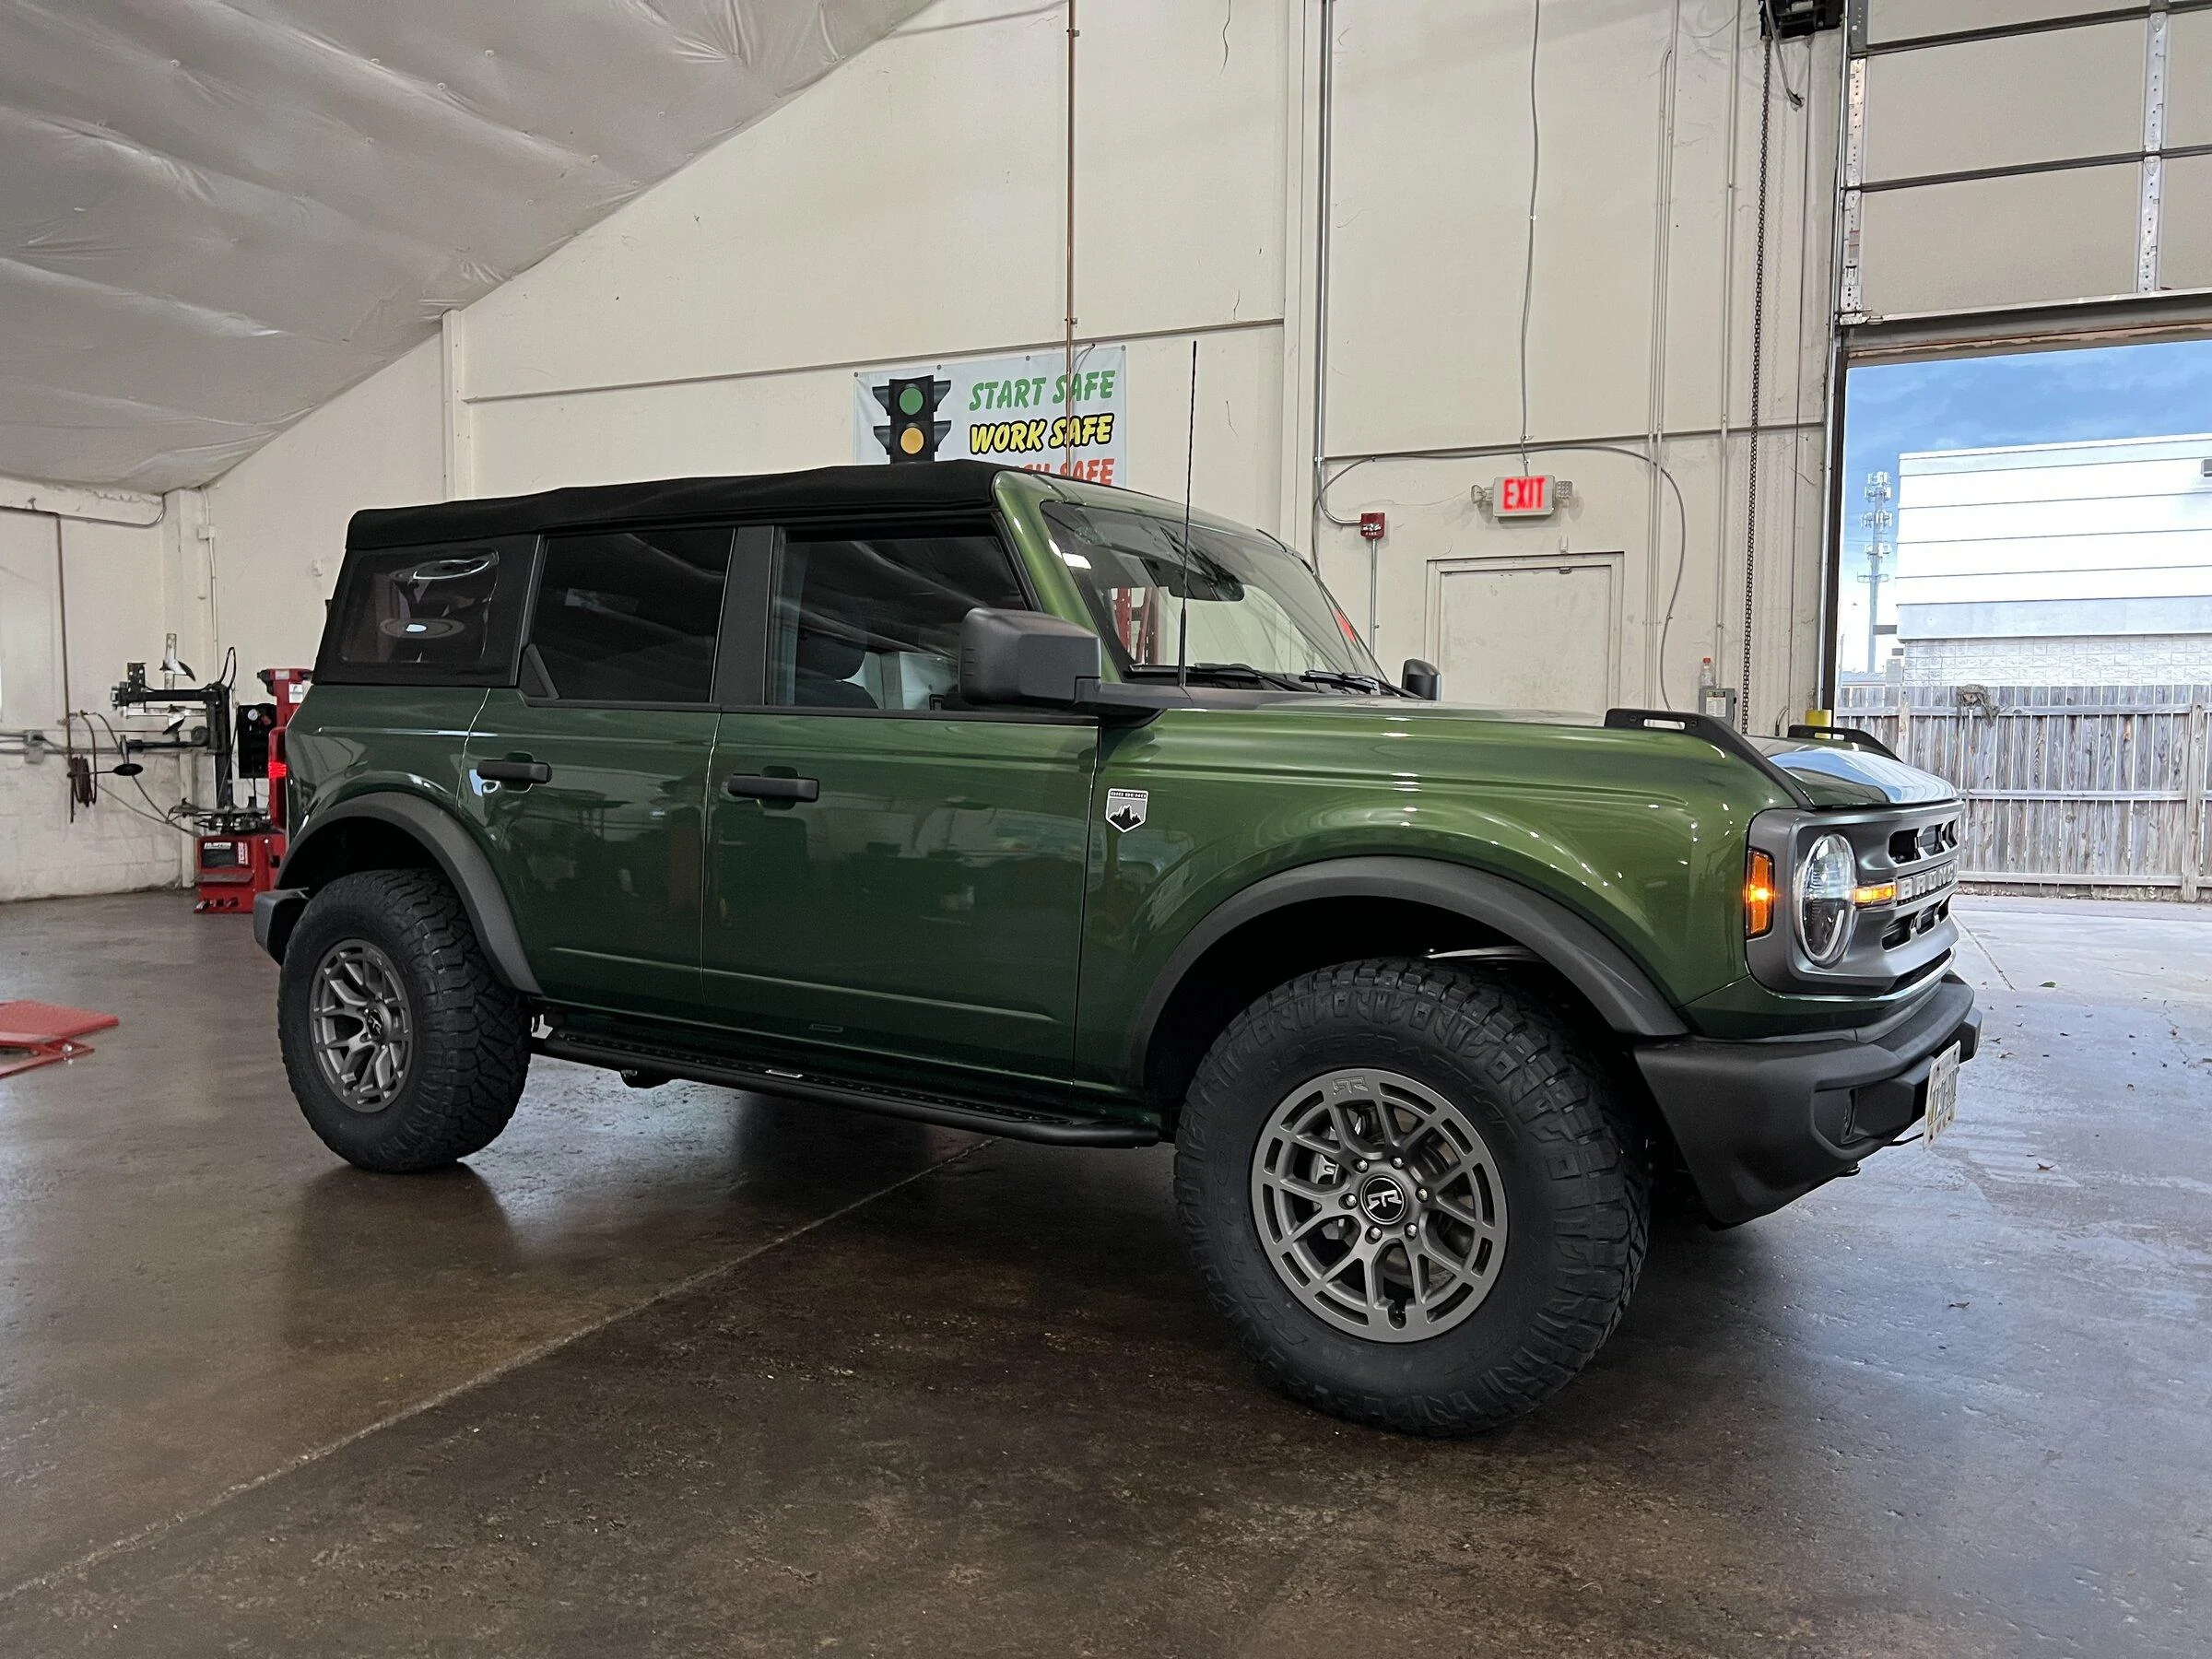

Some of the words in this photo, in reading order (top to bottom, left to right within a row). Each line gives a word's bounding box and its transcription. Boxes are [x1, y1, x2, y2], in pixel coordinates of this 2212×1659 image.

[969, 377, 1047, 411] START
[1053, 370, 1116, 405] SAFE
[969, 418, 1048, 454] WORK
[1048, 412, 1115, 450] SAFE
[1503, 477, 1545, 510] EXIT
